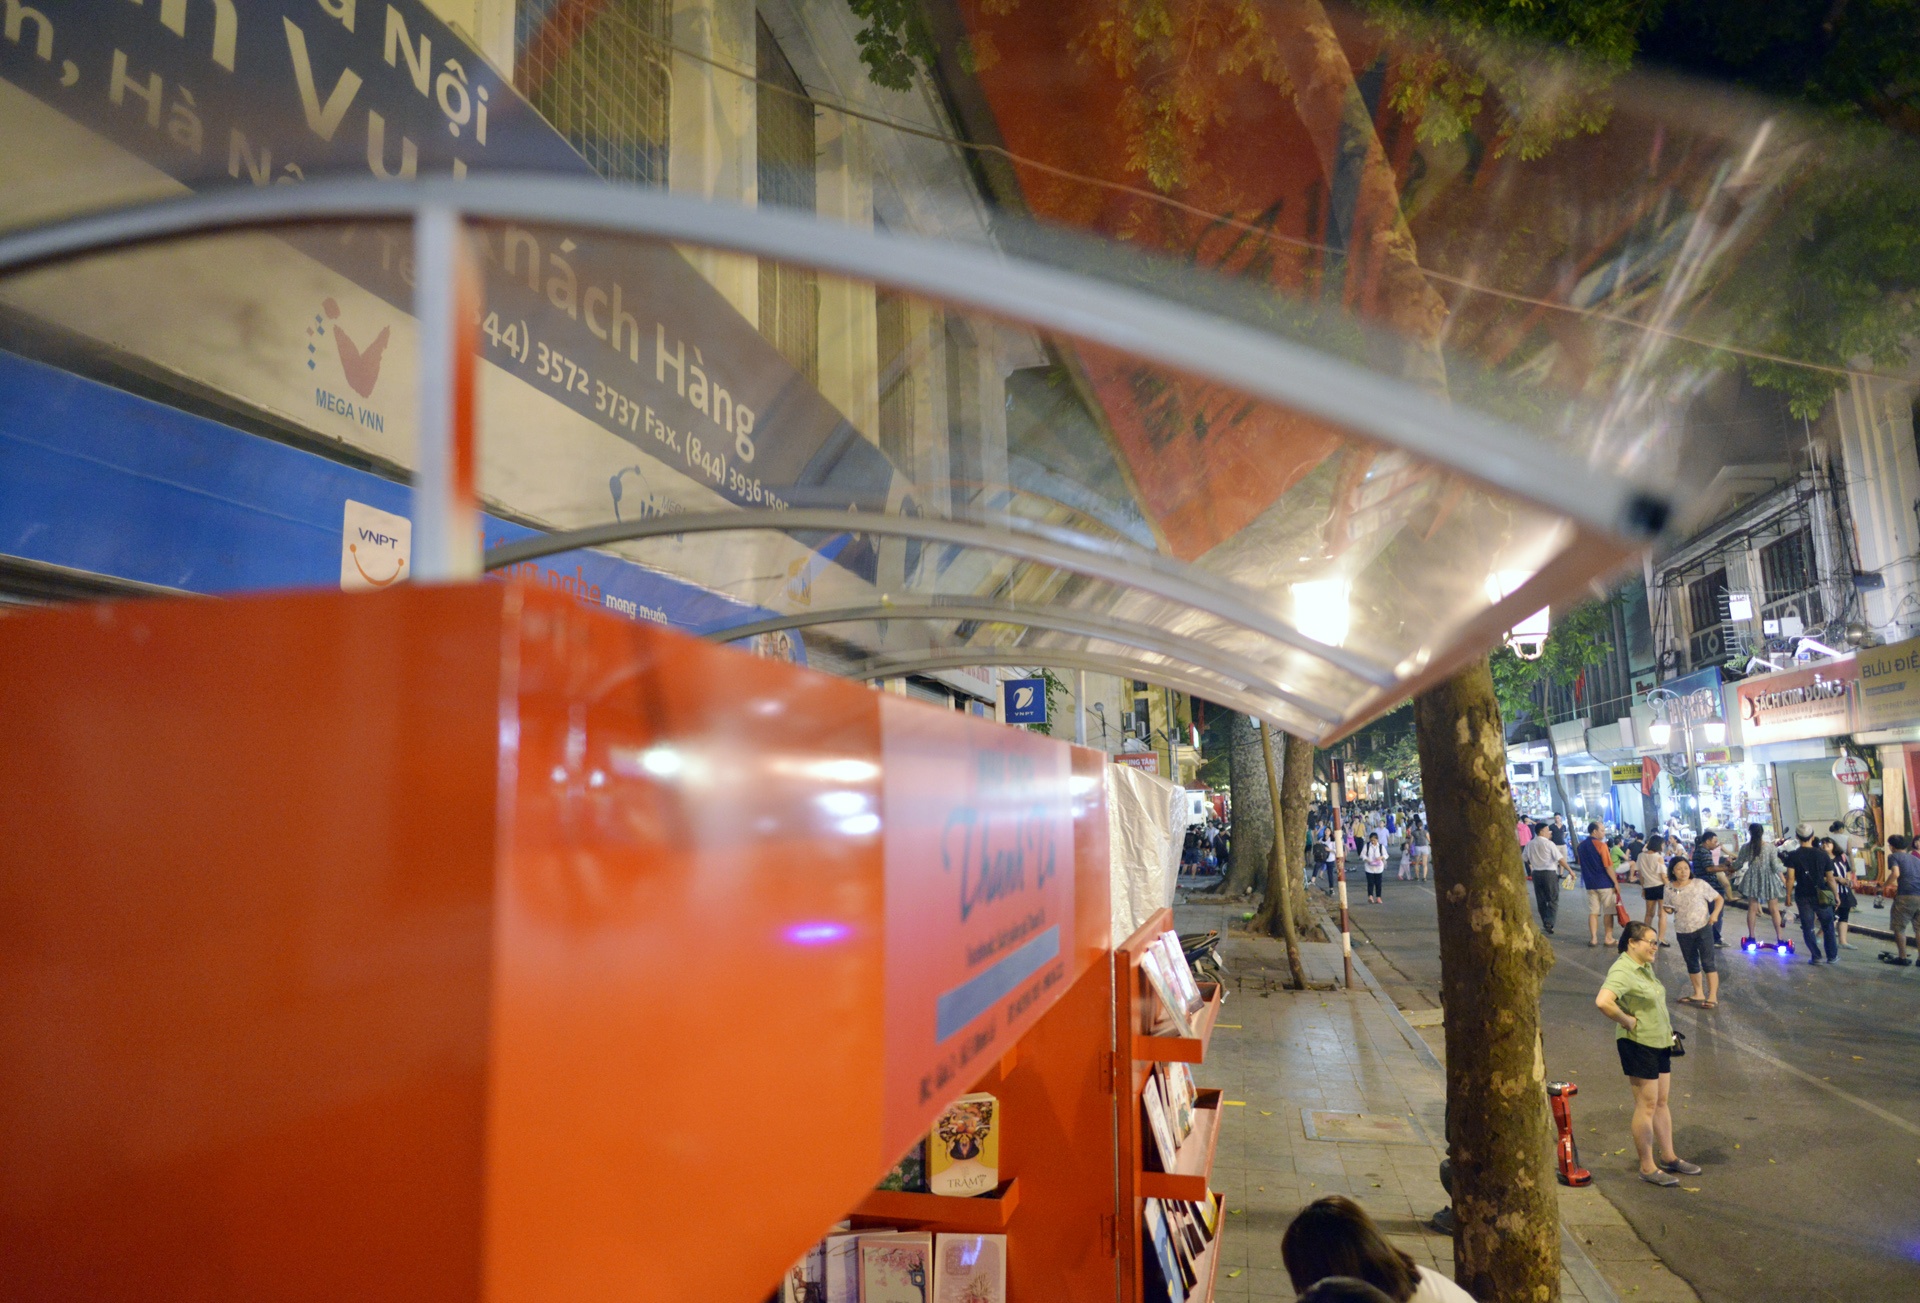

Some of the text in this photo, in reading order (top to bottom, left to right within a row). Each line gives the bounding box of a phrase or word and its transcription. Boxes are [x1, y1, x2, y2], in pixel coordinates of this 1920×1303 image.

[384, 3, 488, 147] Nội
[316, 387, 384, 433] MEGA VNN
[656, 322, 756, 463] Hàng
[536, 341, 590, 396] 3572
[595, 379, 641, 432] 3737
[645, 405, 682, 454] Fax.
[686, 431, 726, 486] (844)
[729, 466, 762, 503] 3936
[358, 527, 399, 549] VNPT
[606, 593, 637, 621] mong
[639, 604, 668, 626] muốn
[1780, 687, 1804, 707] KIM
